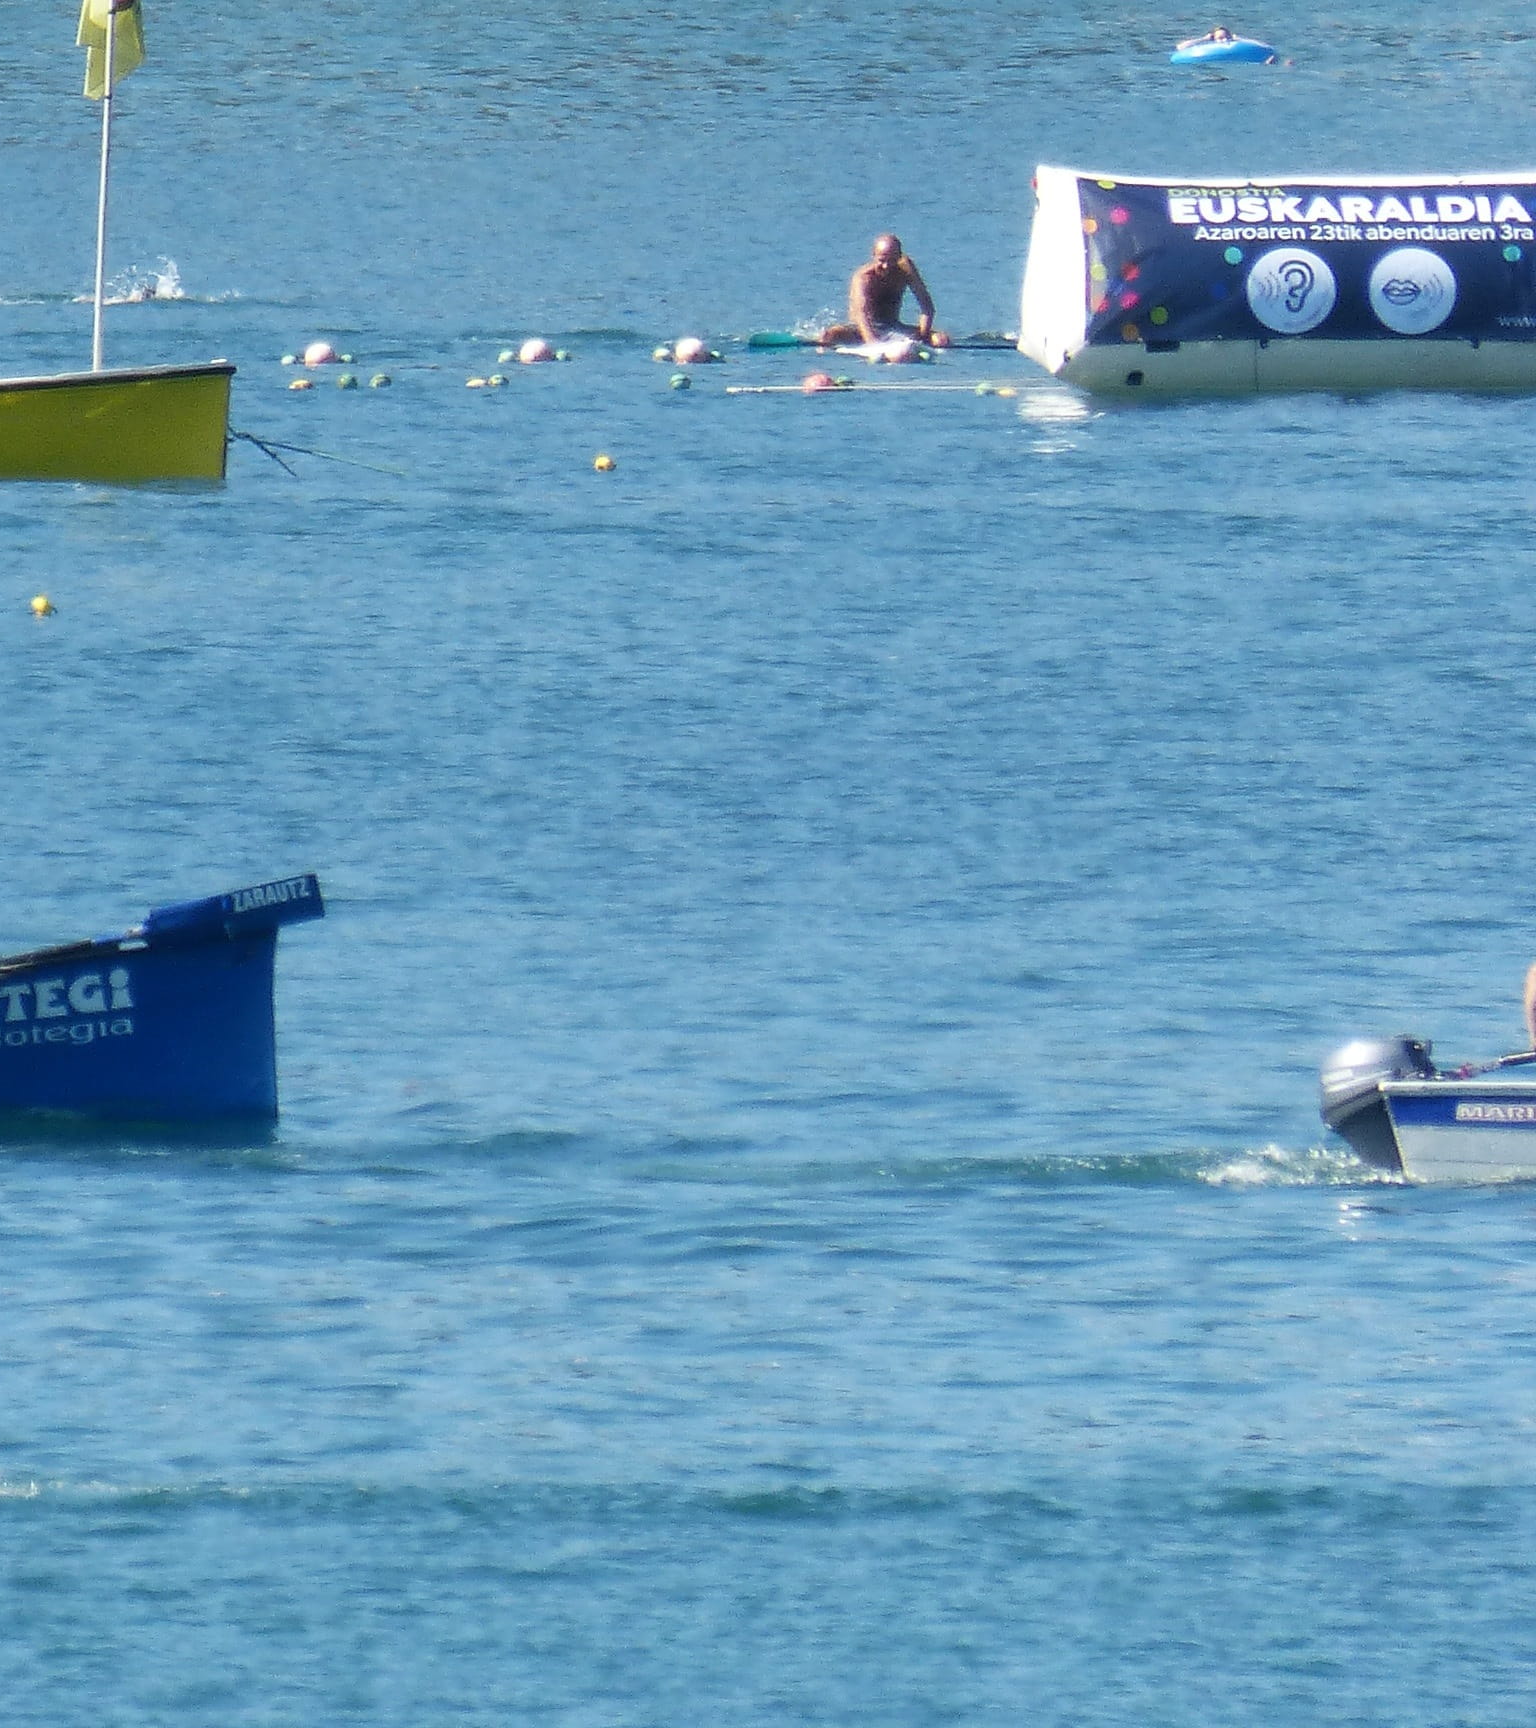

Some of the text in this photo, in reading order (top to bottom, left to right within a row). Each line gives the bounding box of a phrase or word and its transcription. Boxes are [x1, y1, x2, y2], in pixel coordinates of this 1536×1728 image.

[1168, 195, 1533, 224] EUSKARALDIA
[1194, 224, 1534, 241] Azaroaren 23tik abenduaren 3ra
[232, 878, 309, 914] ZARAUTZ
